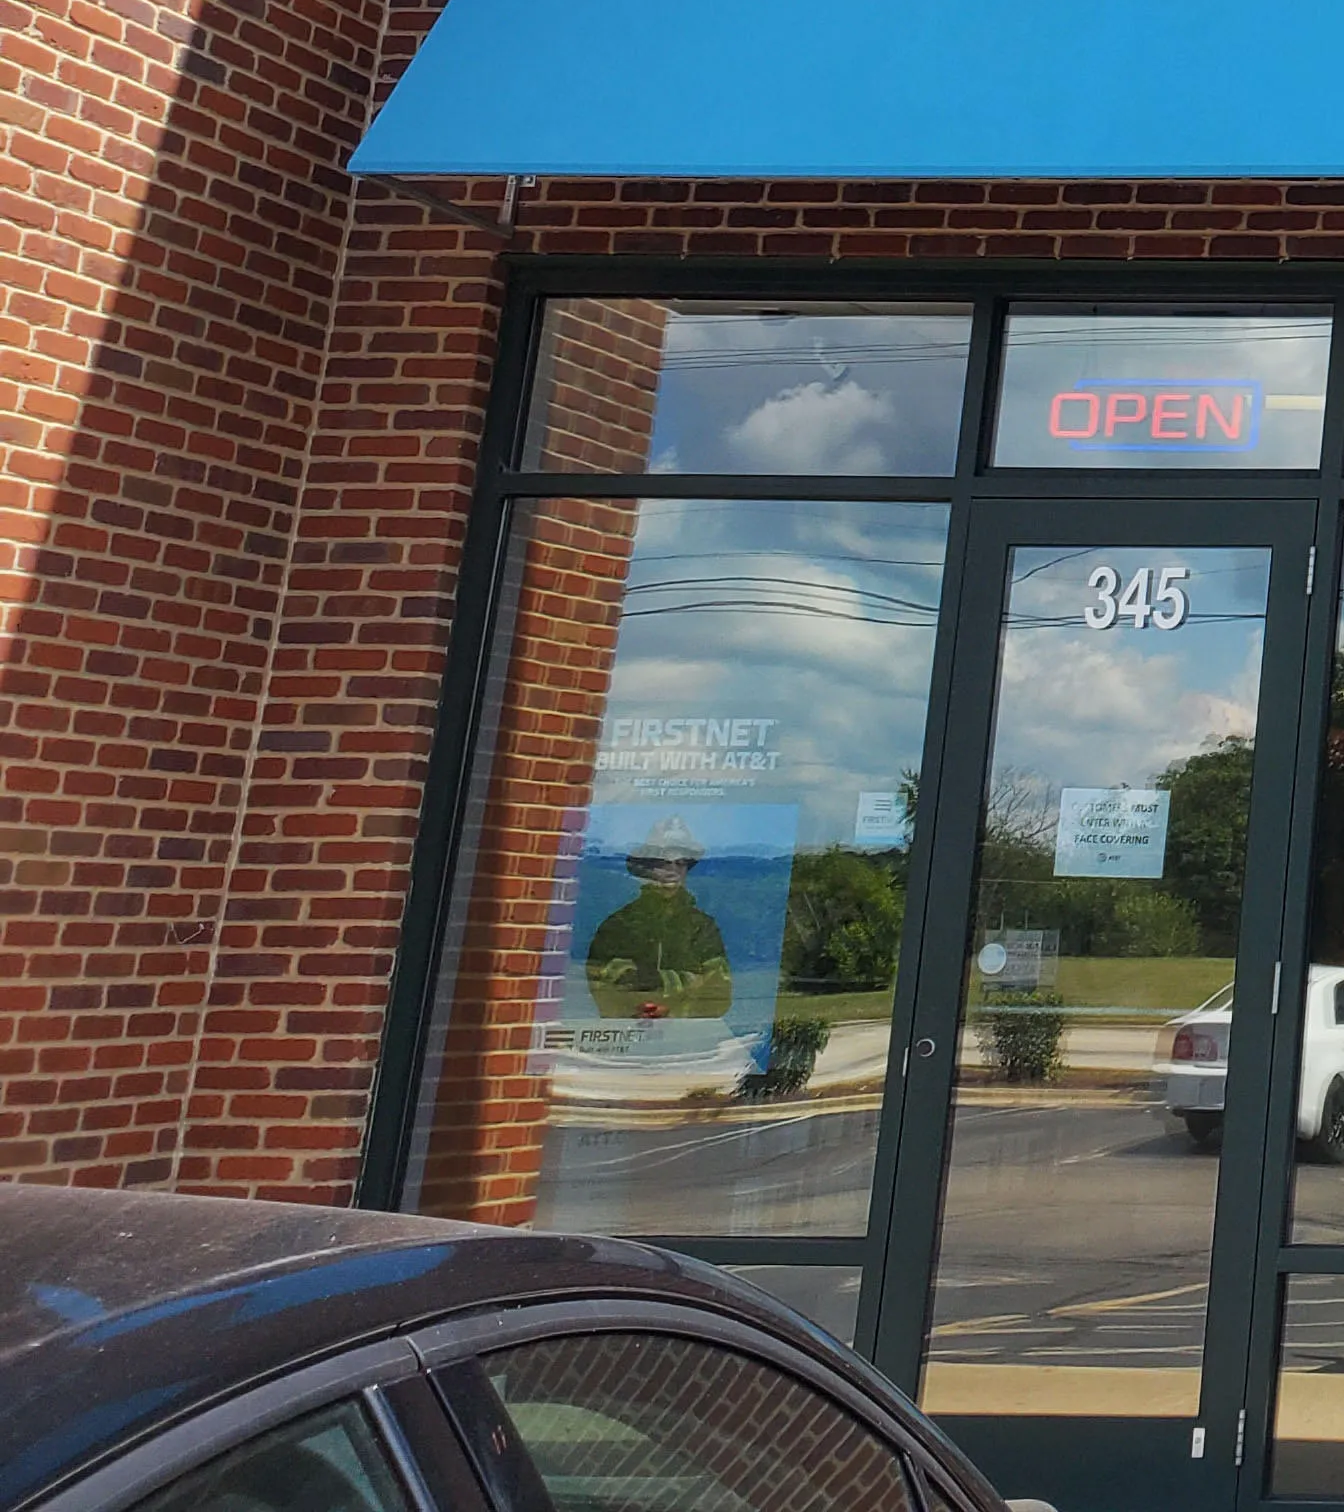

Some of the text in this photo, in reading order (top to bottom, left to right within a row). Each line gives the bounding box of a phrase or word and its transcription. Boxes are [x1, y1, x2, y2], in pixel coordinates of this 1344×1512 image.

[1048, 392, 1244, 439] OPEN
[1084, 566, 1190, 630] 345
[610, 719, 776, 747] FIRSTNET
[595, 751, 781, 771] BUILT WITH AT&T
[1074, 834, 1150, 845] FACE COVERING
[580, 1030, 645, 1042] FIRSTNET
